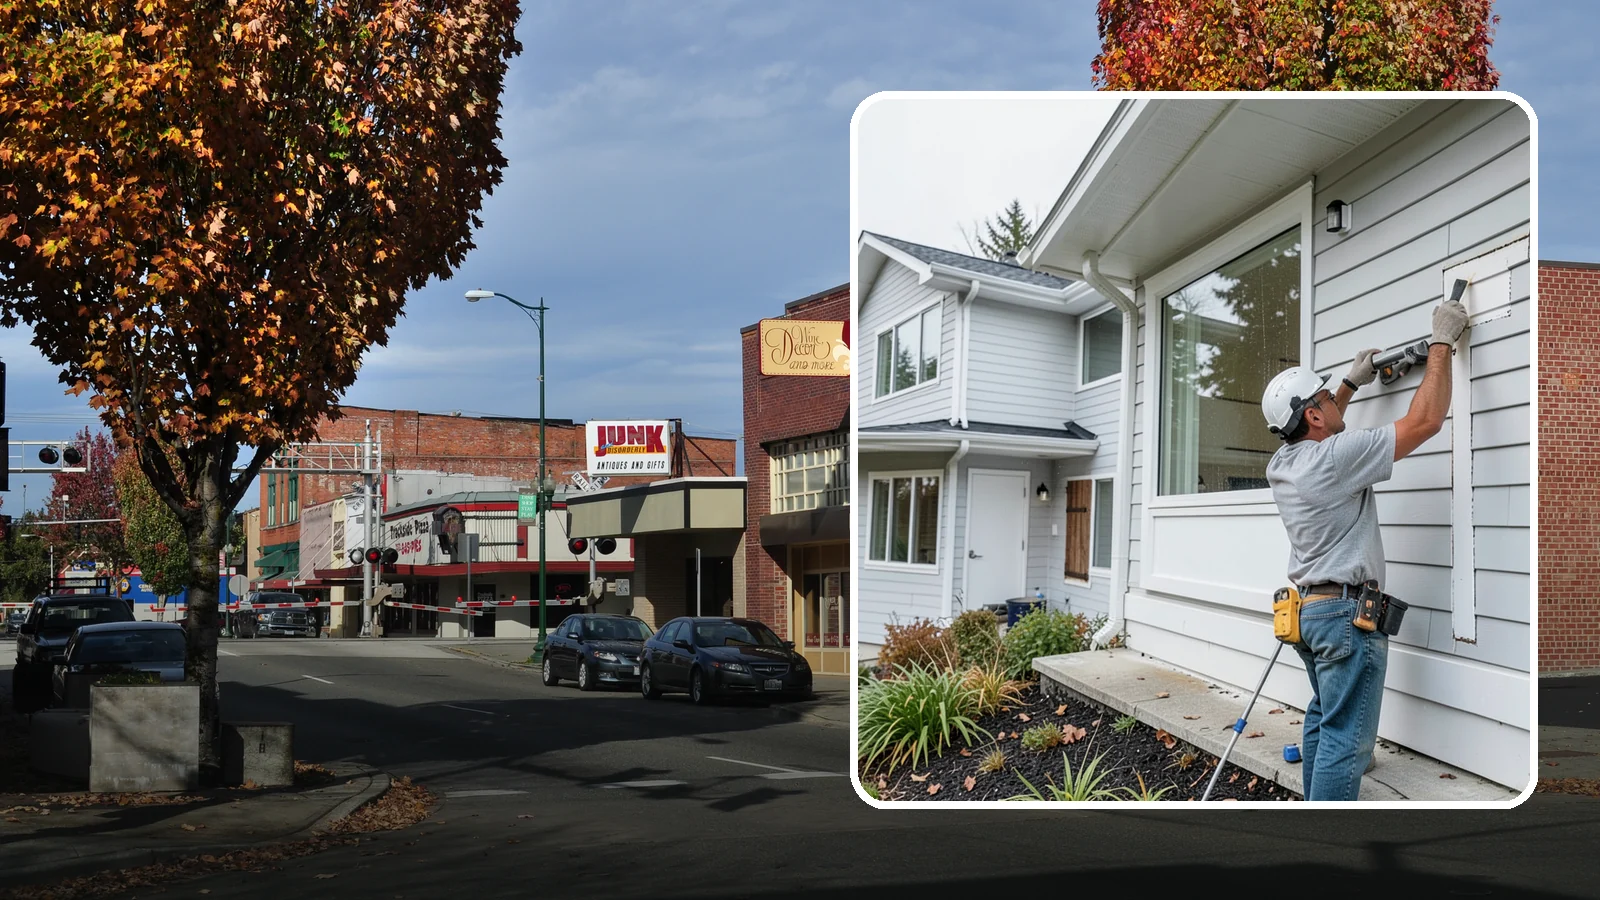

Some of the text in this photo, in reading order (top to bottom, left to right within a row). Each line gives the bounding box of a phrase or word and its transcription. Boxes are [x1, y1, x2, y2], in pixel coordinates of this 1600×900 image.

[595, 425, 665, 457] JUNK
[607, 446, 646, 454] DISORDERLY
[597, 460, 665, 470] ANTIQUES AND GIFTS
[590, 475, 608, 492] SING
[415, 519, 429, 534] Pizza
